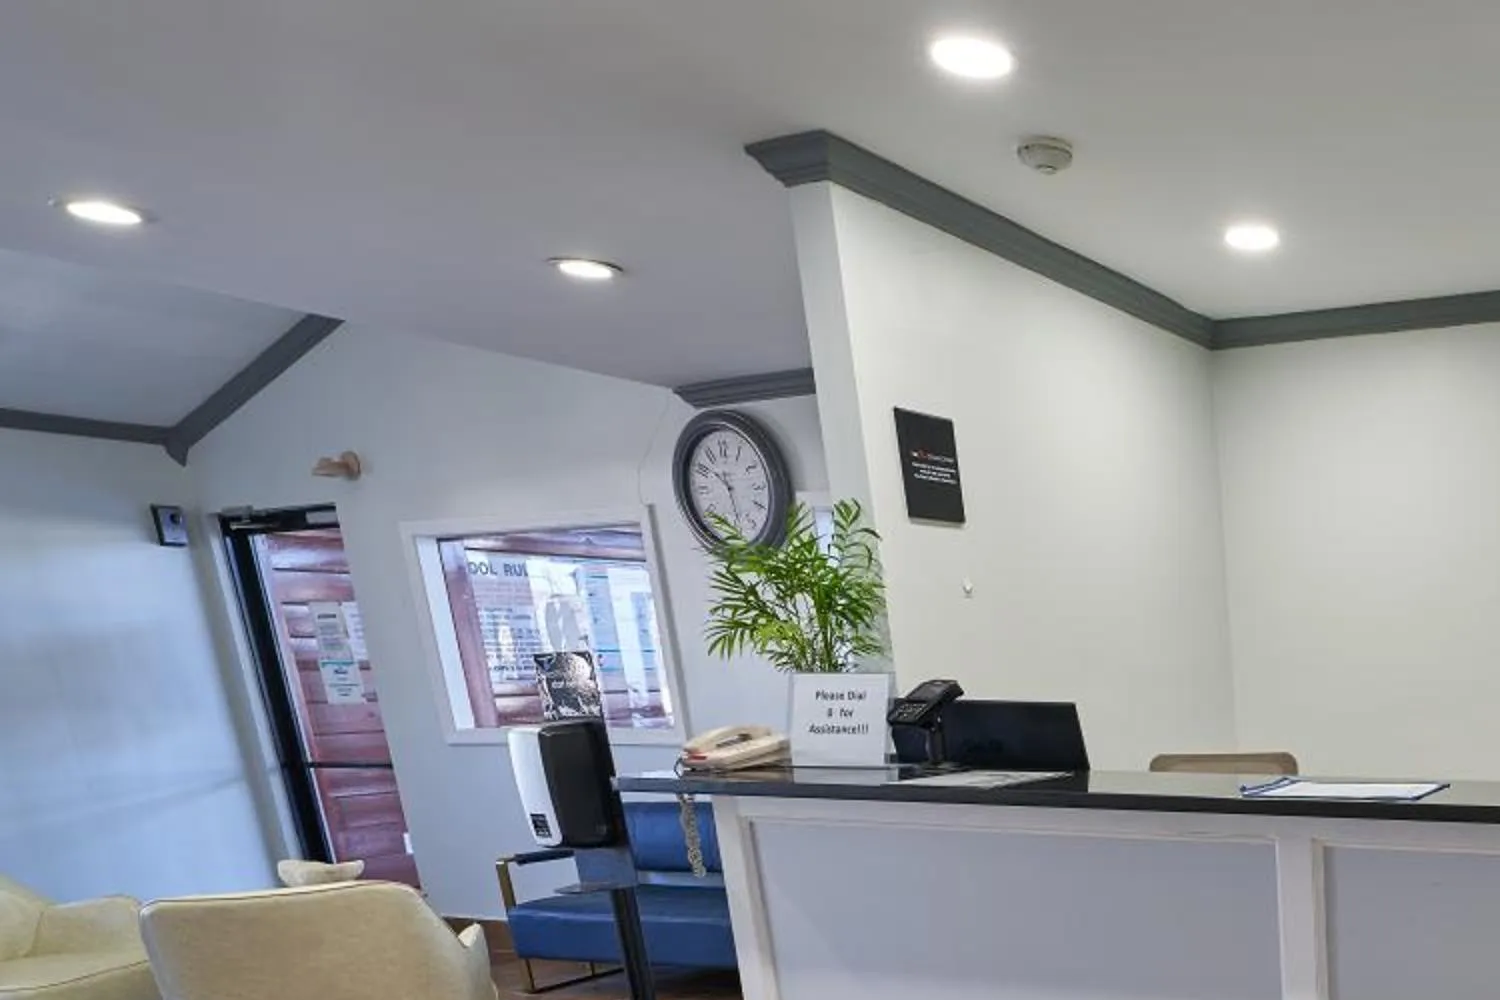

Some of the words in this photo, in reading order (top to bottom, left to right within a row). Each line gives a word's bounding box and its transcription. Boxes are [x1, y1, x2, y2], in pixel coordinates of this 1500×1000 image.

[467, 561, 498, 576] OOL
[503, 562, 529, 577] RUL
[815, 690, 845, 701] Please
[847, 690, 867, 701] Dial
[839, 707, 854, 717] for
[808, 723, 870, 735] Assistance!!!
